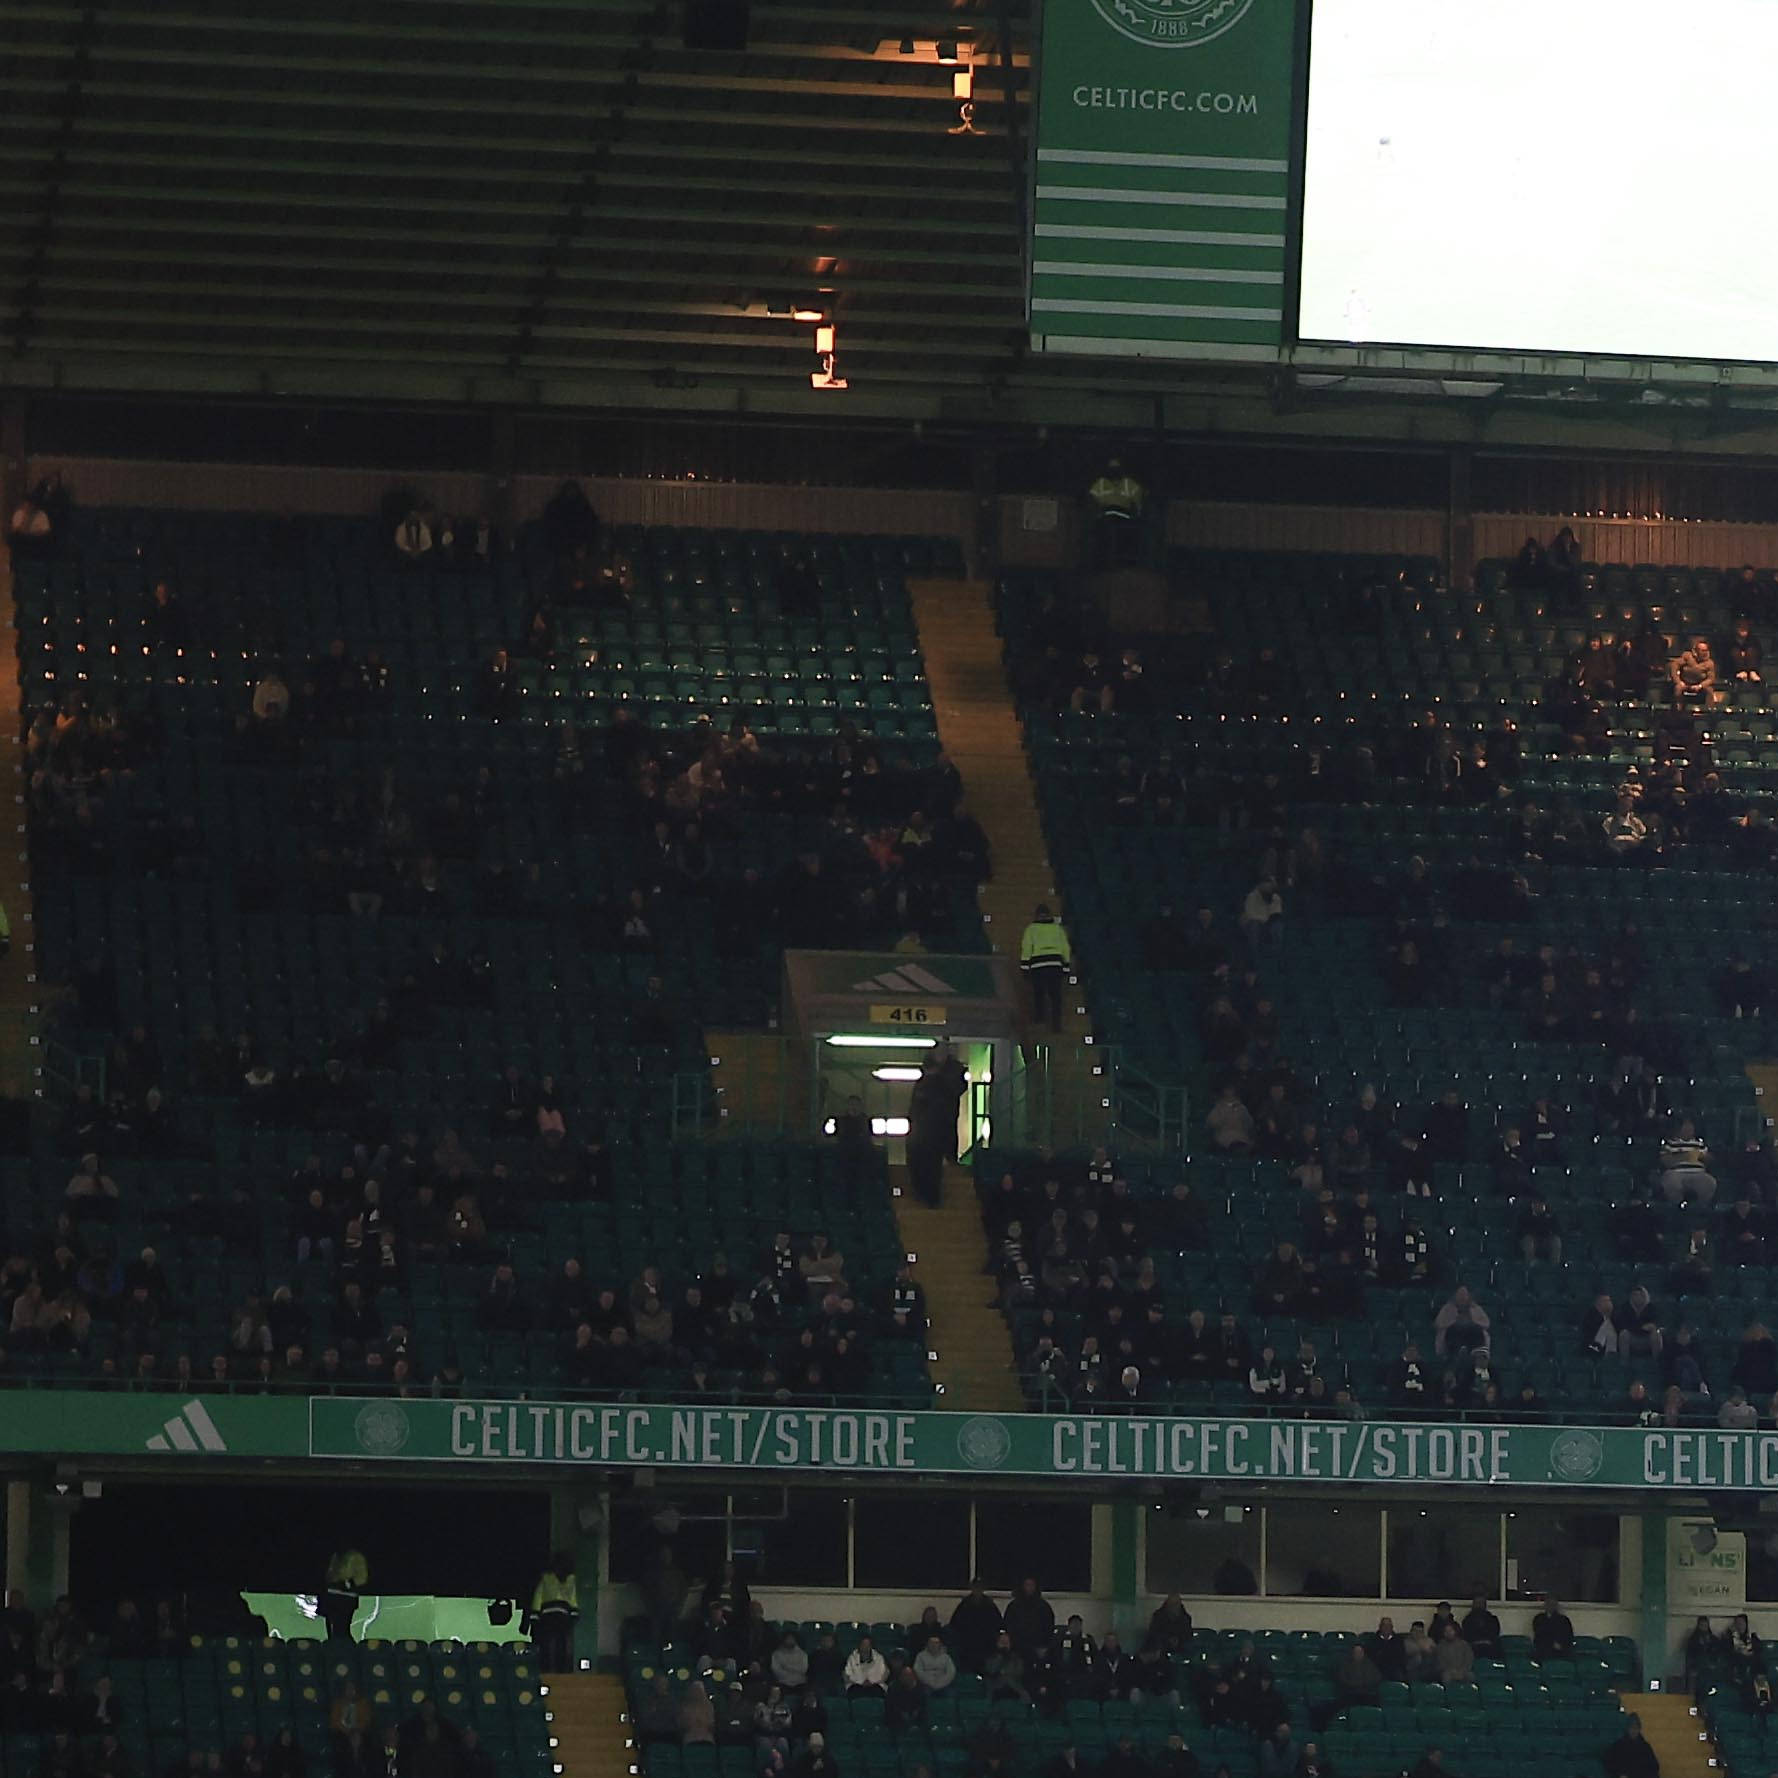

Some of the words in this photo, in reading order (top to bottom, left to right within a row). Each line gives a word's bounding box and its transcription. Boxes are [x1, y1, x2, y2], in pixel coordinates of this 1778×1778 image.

[1151, 19, 1188, 36] 1888
[1073, 86, 1258, 114] CELTICFC.COM
[889, 1008, 928, 1022] 416
[451, 1405, 915, 1467] CELTICFC.NET/STORE
[1053, 1420, 1510, 1479] CELTICFC.NET/STORE
